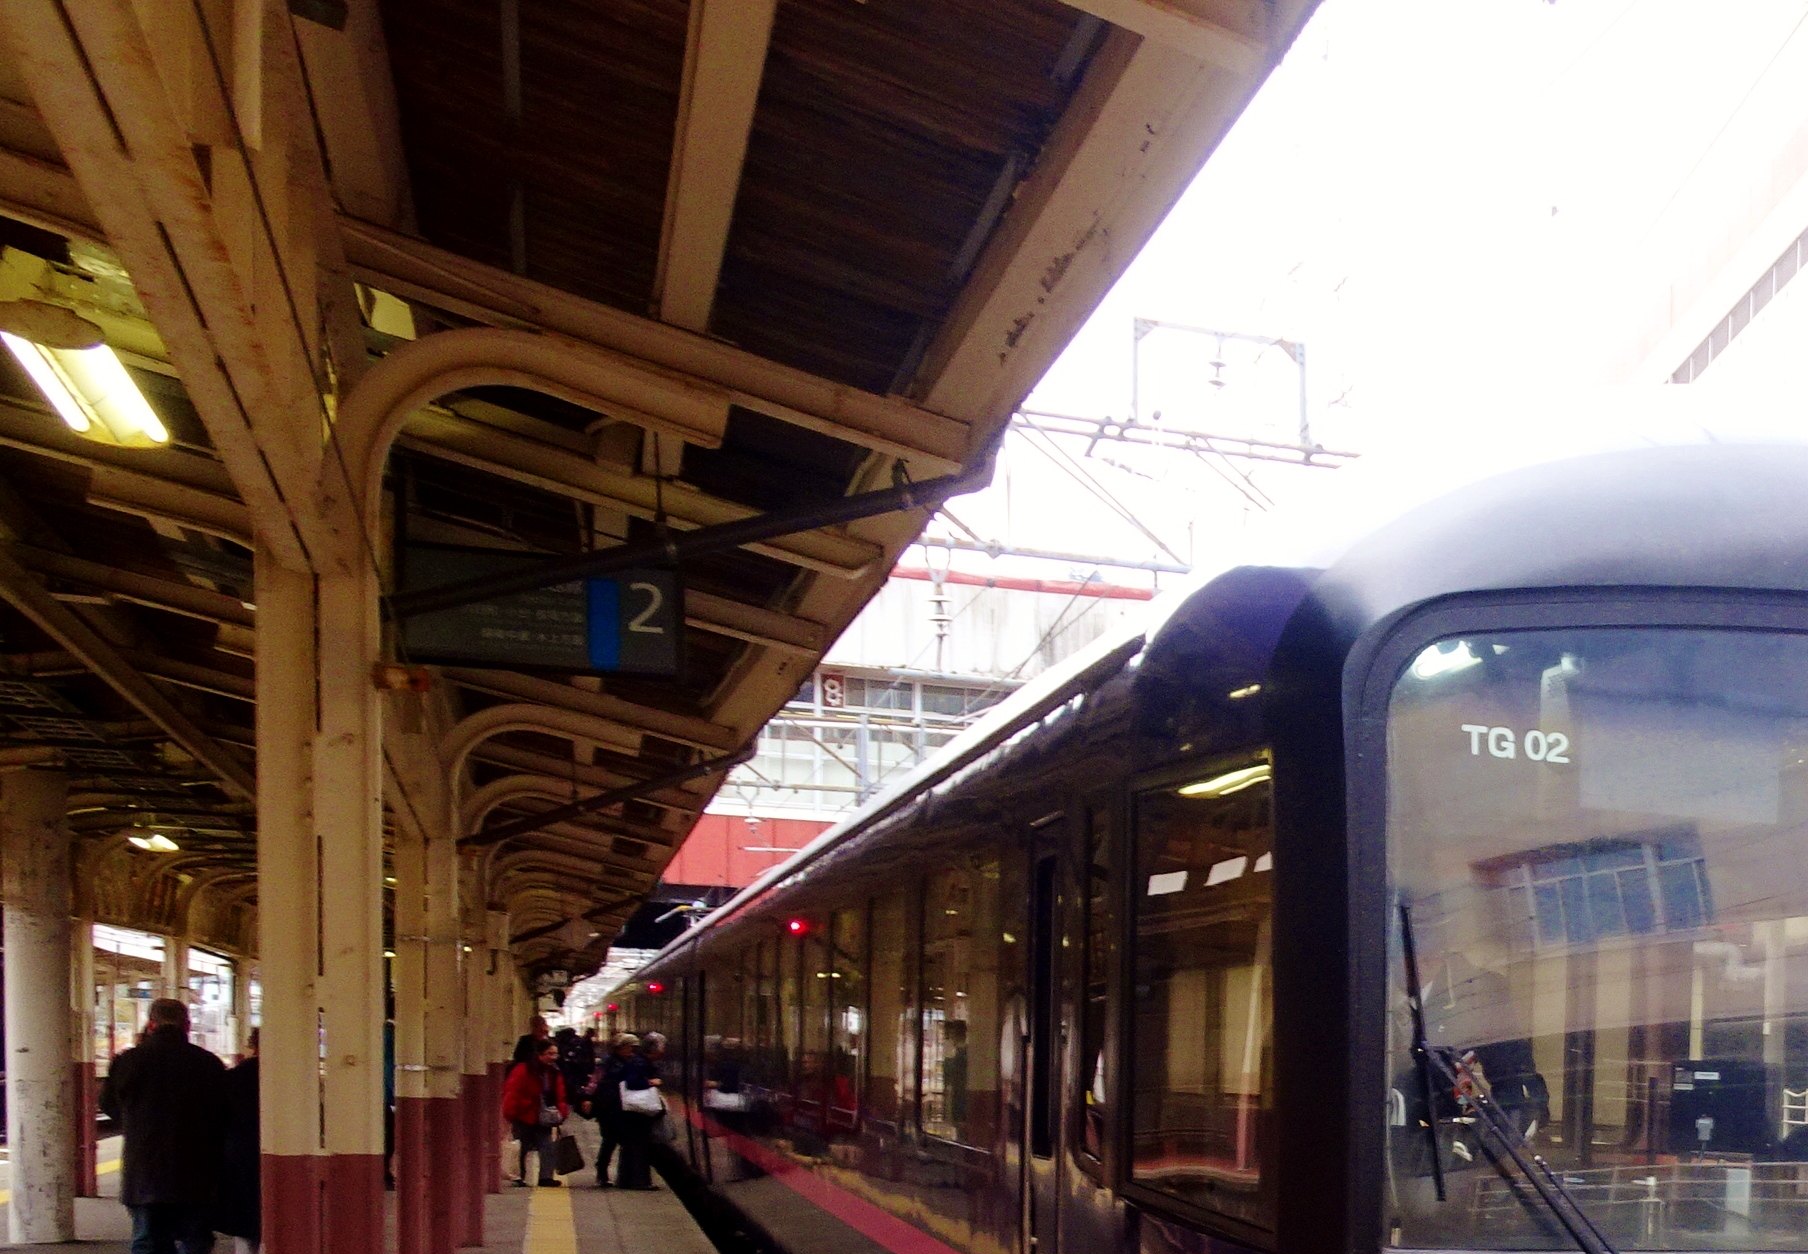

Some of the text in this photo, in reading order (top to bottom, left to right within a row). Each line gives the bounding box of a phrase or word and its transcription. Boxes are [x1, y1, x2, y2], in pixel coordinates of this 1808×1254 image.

[629, 583, 664, 634] 2
[1461, 724, 1570, 764] TG 02
